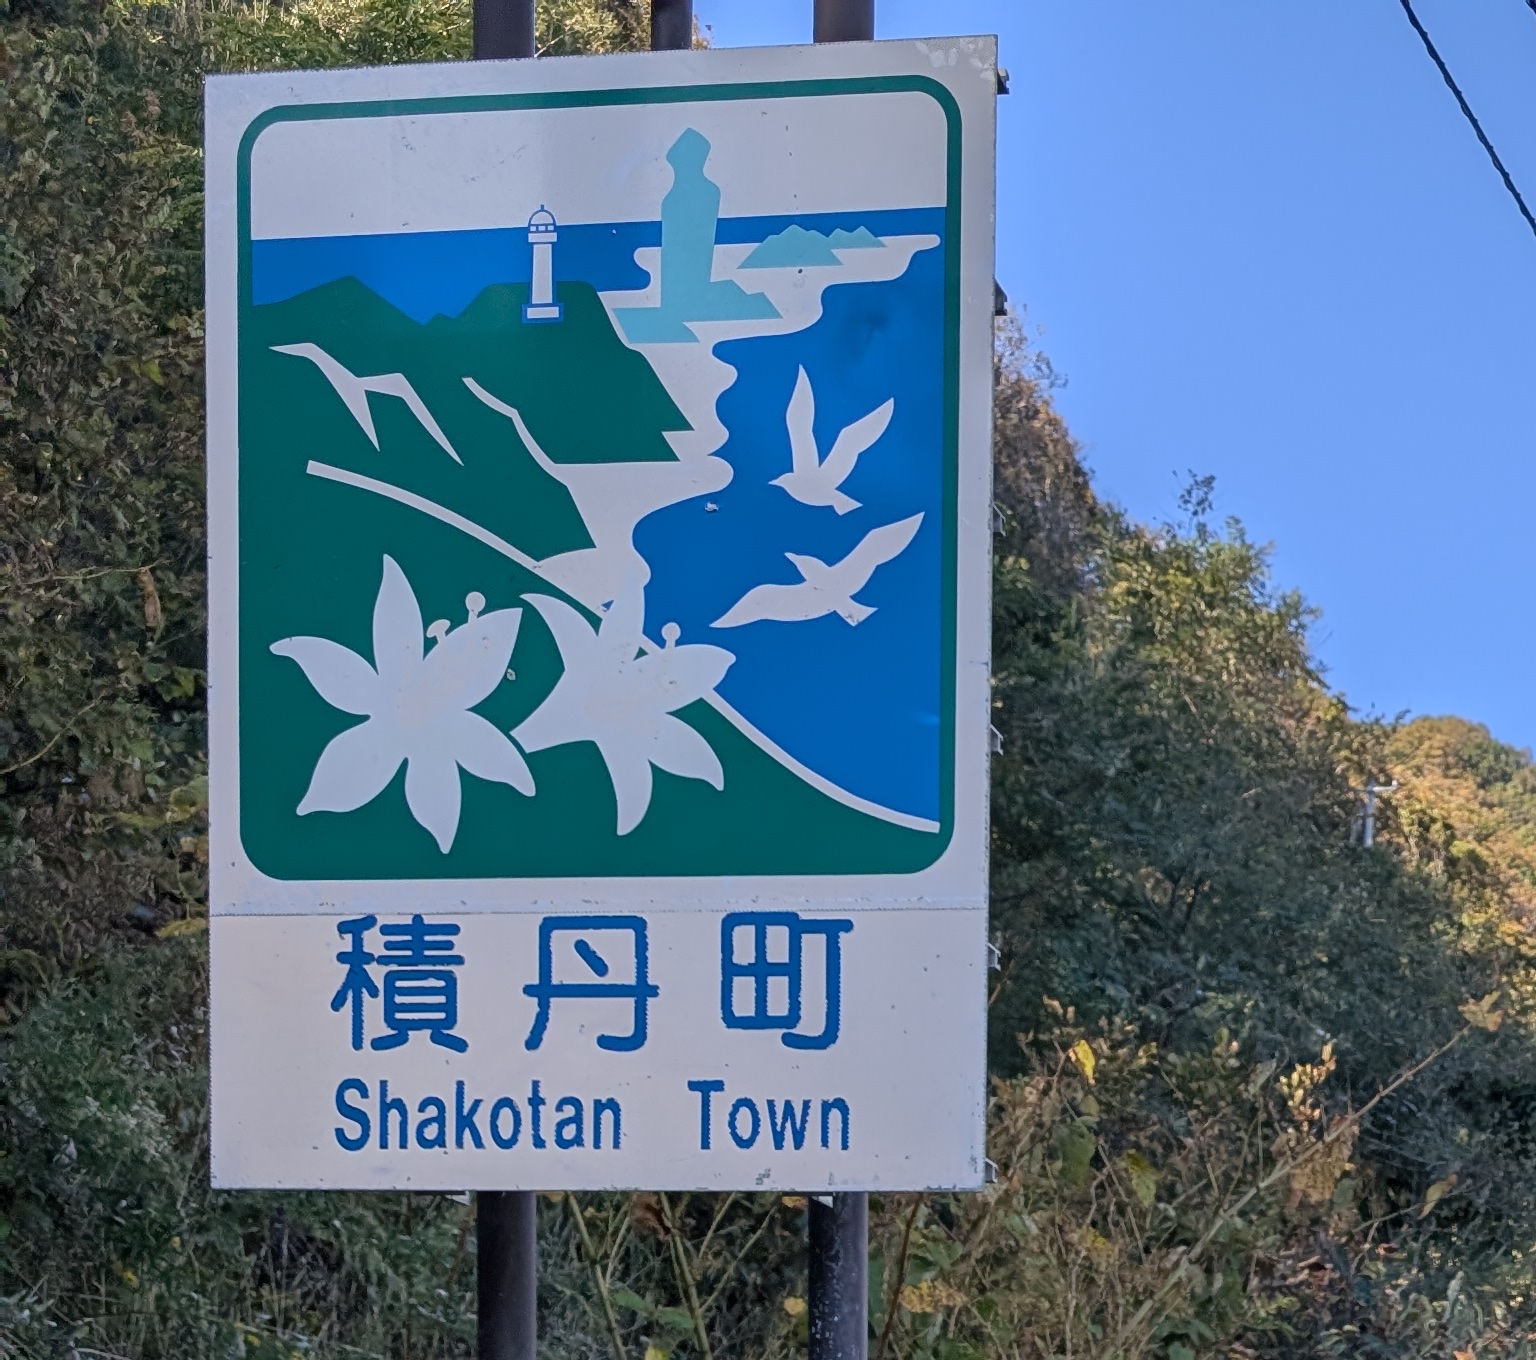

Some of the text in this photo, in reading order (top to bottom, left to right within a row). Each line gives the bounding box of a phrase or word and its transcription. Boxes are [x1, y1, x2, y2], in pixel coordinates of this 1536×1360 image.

[330, 911, 854, 1052] 積丹町
[334, 1077, 851, 1152] Shakotan Town
